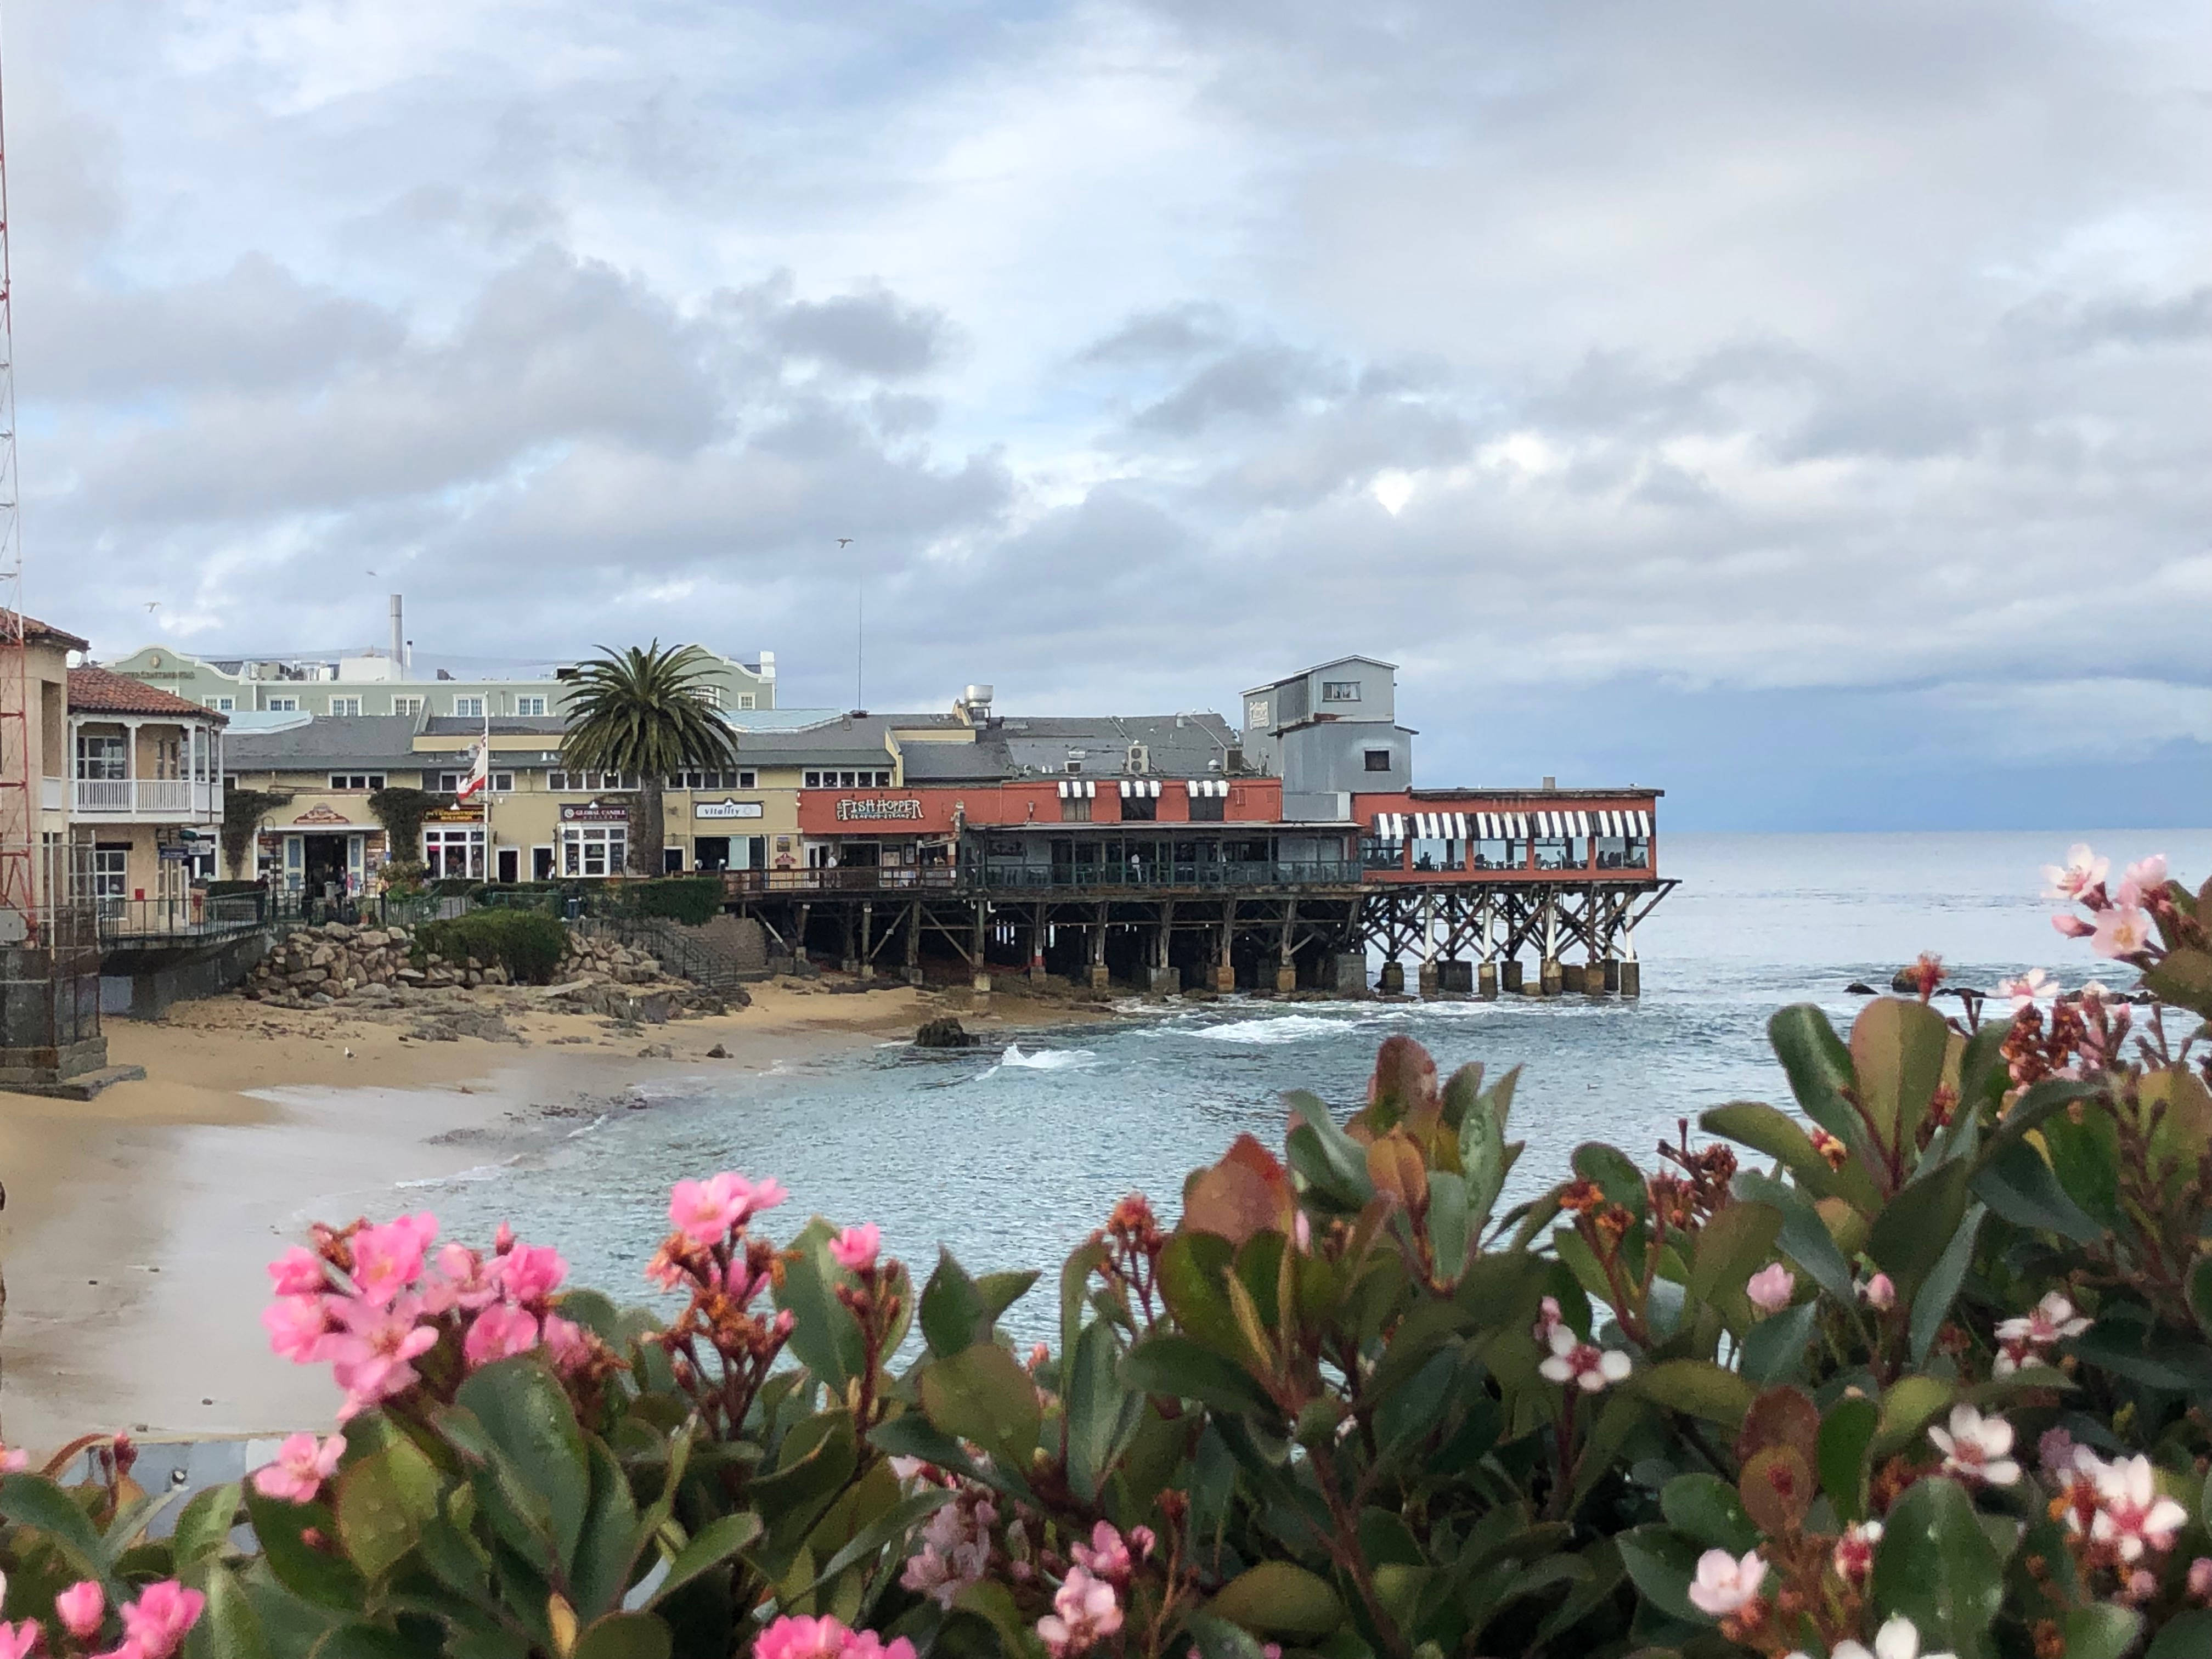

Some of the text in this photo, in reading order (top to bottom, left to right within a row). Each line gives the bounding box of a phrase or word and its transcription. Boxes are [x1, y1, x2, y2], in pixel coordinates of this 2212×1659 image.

[704, 806, 739, 817] vitality
[841, 799, 924, 820] FISH HOPPER
